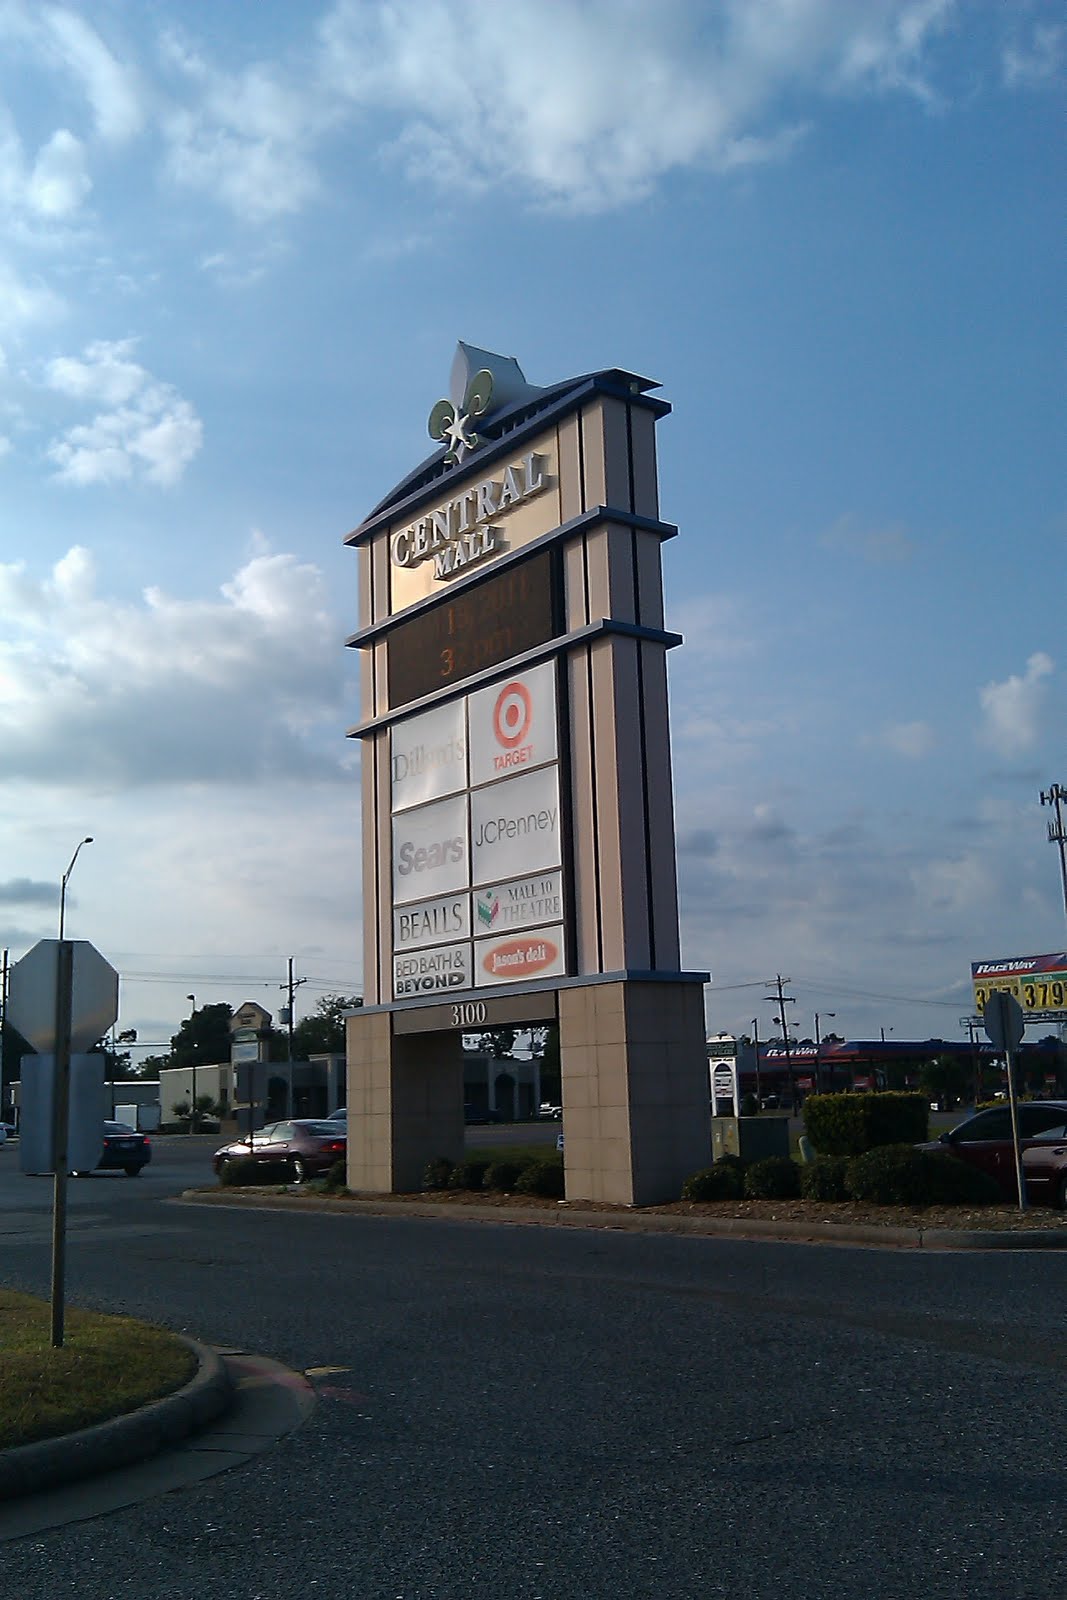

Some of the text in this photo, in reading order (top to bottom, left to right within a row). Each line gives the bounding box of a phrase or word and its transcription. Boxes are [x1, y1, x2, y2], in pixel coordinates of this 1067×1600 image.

[392, 452, 545, 567] CENTRAL
[433, 526, 497, 580] MALL
[493, 745, 534, 772] TARGET
[475, 807, 557, 846] JCPenney
[398, 837, 464, 875] Sears
[508, 880, 553, 901] MALL 10
[400, 903, 463, 941] BEALLS
[502, 896, 560, 922] THEATRE
[526, 942, 546, 963] deli
[396, 958, 419, 977] BED
[397, 971, 465, 994] BEYOND
[451, 1001, 486, 1026] 3100
